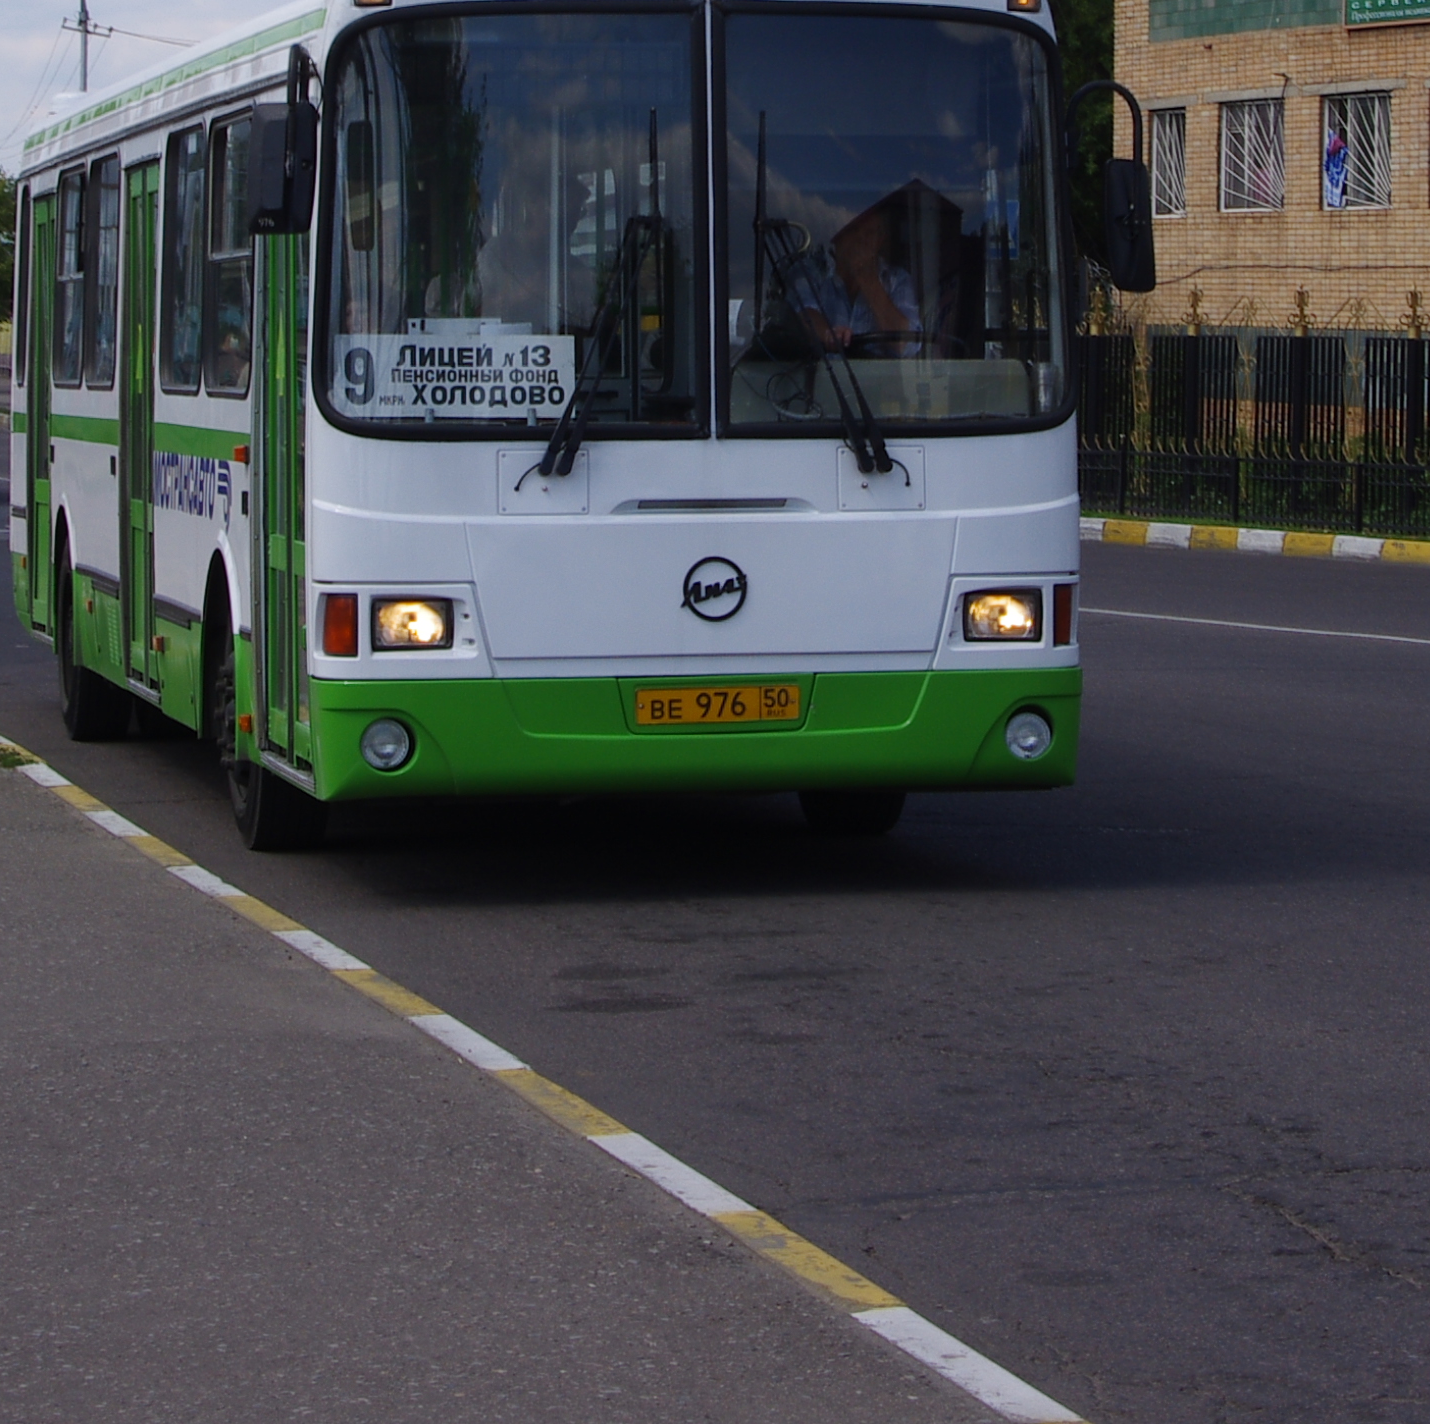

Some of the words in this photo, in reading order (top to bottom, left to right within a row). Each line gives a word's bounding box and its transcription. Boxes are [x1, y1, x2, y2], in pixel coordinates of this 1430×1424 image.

[396, 343, 493, 367] ЛИЦЕЙ
[344, 347, 376, 405] 9
[391, 369, 503, 383] ПЕНСИОННЫЙ
[509, 369, 559, 384] ФОНД
[412, 384, 565, 407] ХОЛОДОВО
[696, 692, 746, 718] 976
[763, 689, 789, 707] 50
